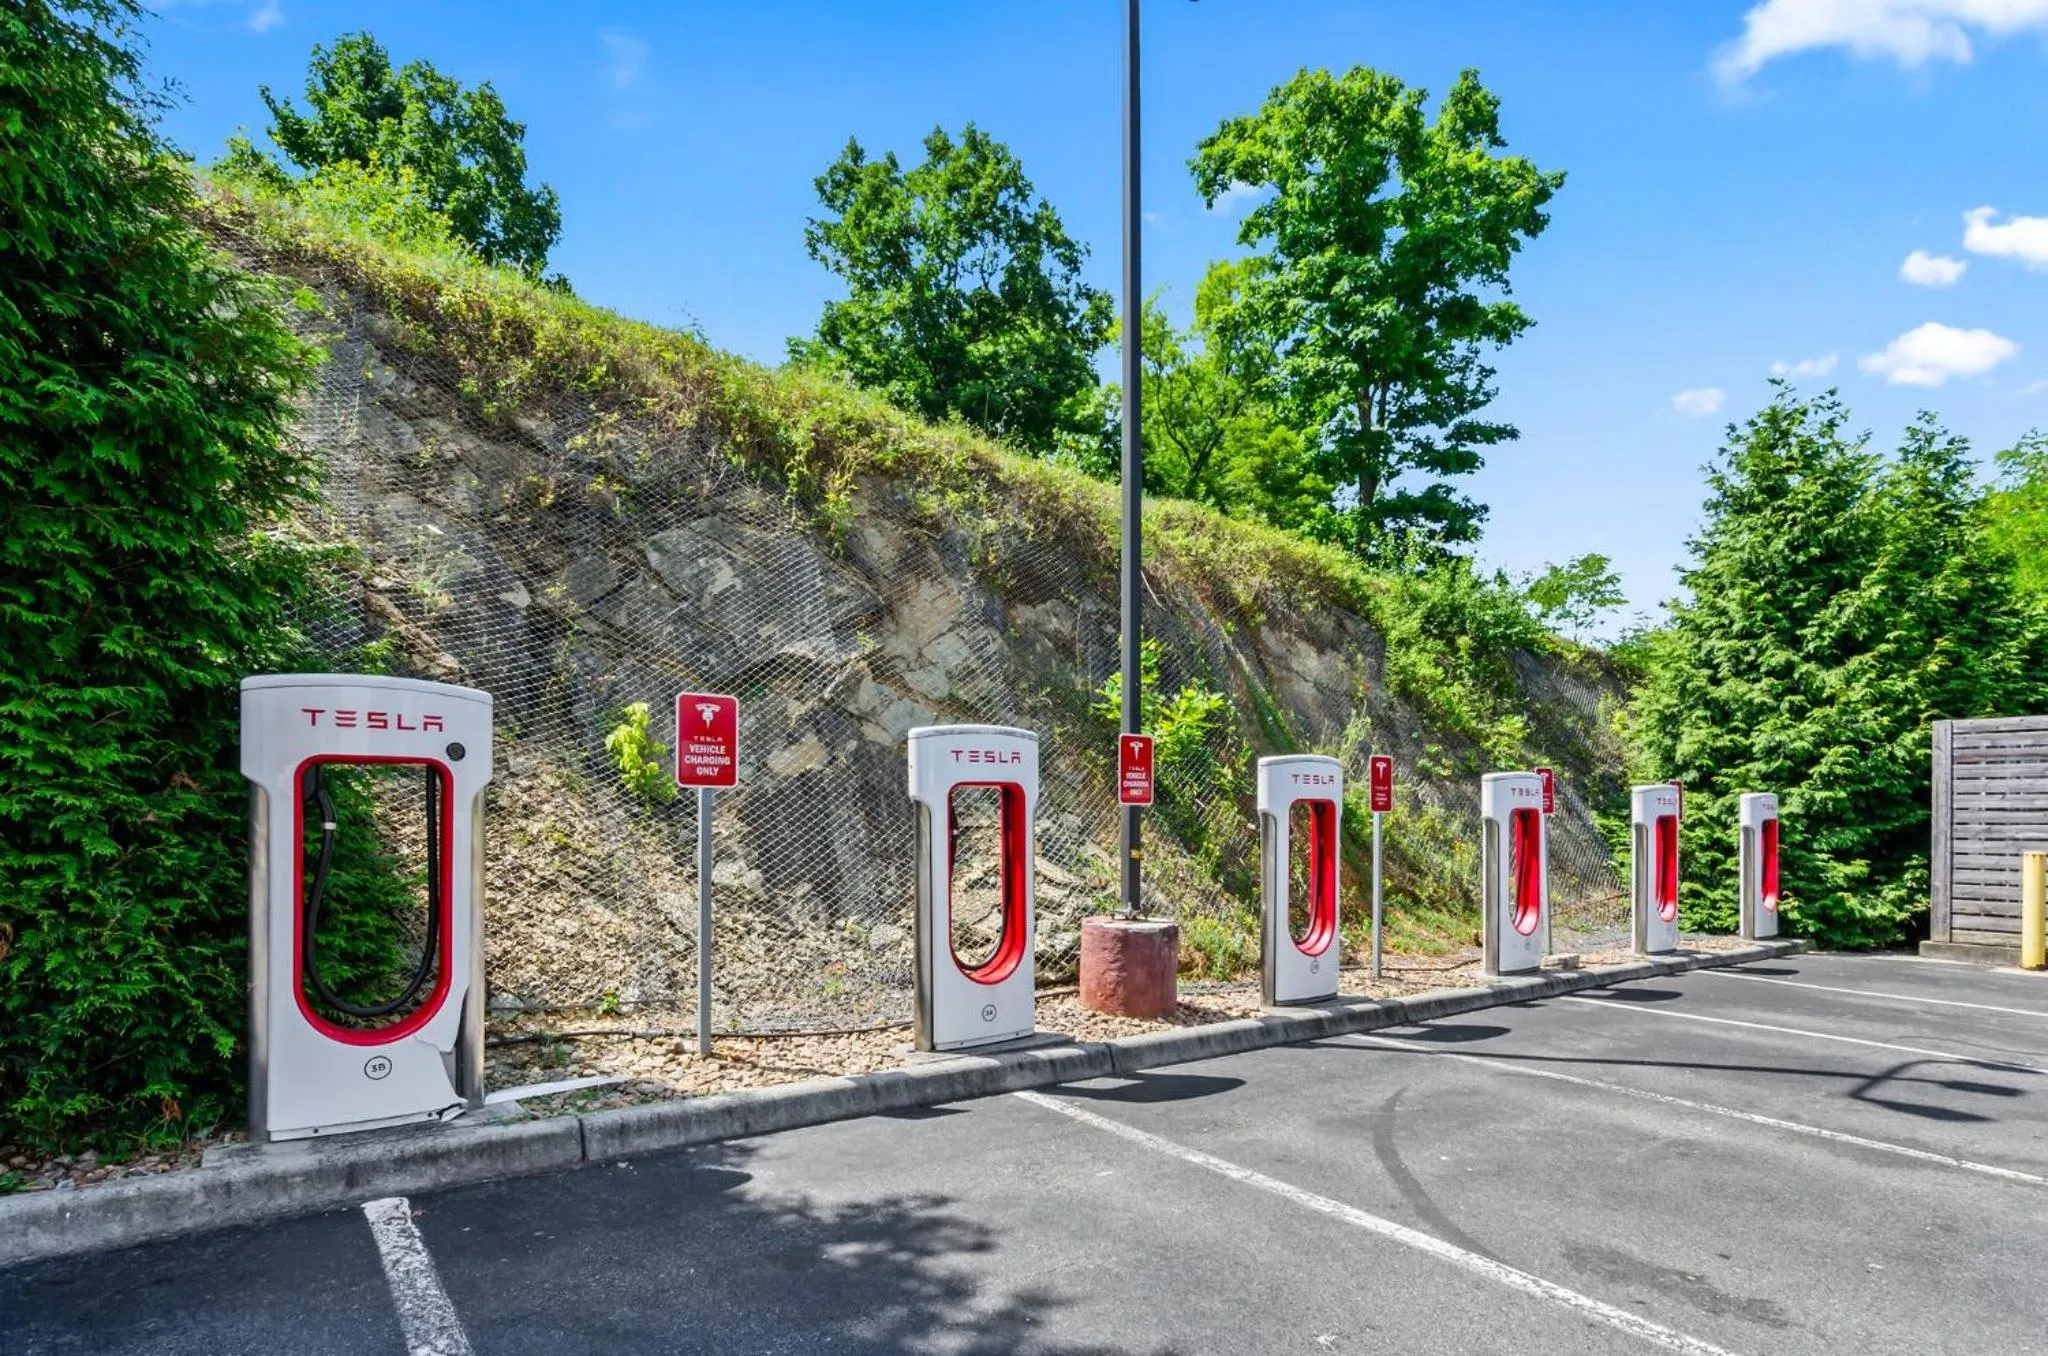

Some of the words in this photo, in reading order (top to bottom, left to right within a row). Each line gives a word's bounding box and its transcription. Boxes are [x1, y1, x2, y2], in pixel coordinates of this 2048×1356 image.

[301, 708, 443, 732] TESLA
[693, 735, 723, 743] TESLA
[689, 744, 726, 754] VEHICLE
[685, 755, 731, 765] CHARGING
[951, 750, 1021, 763] TESLA
[696, 766, 719, 776] ONLY
[1291, 774, 1335, 785] TESLA
[371, 1063, 386, 1073] 3B
